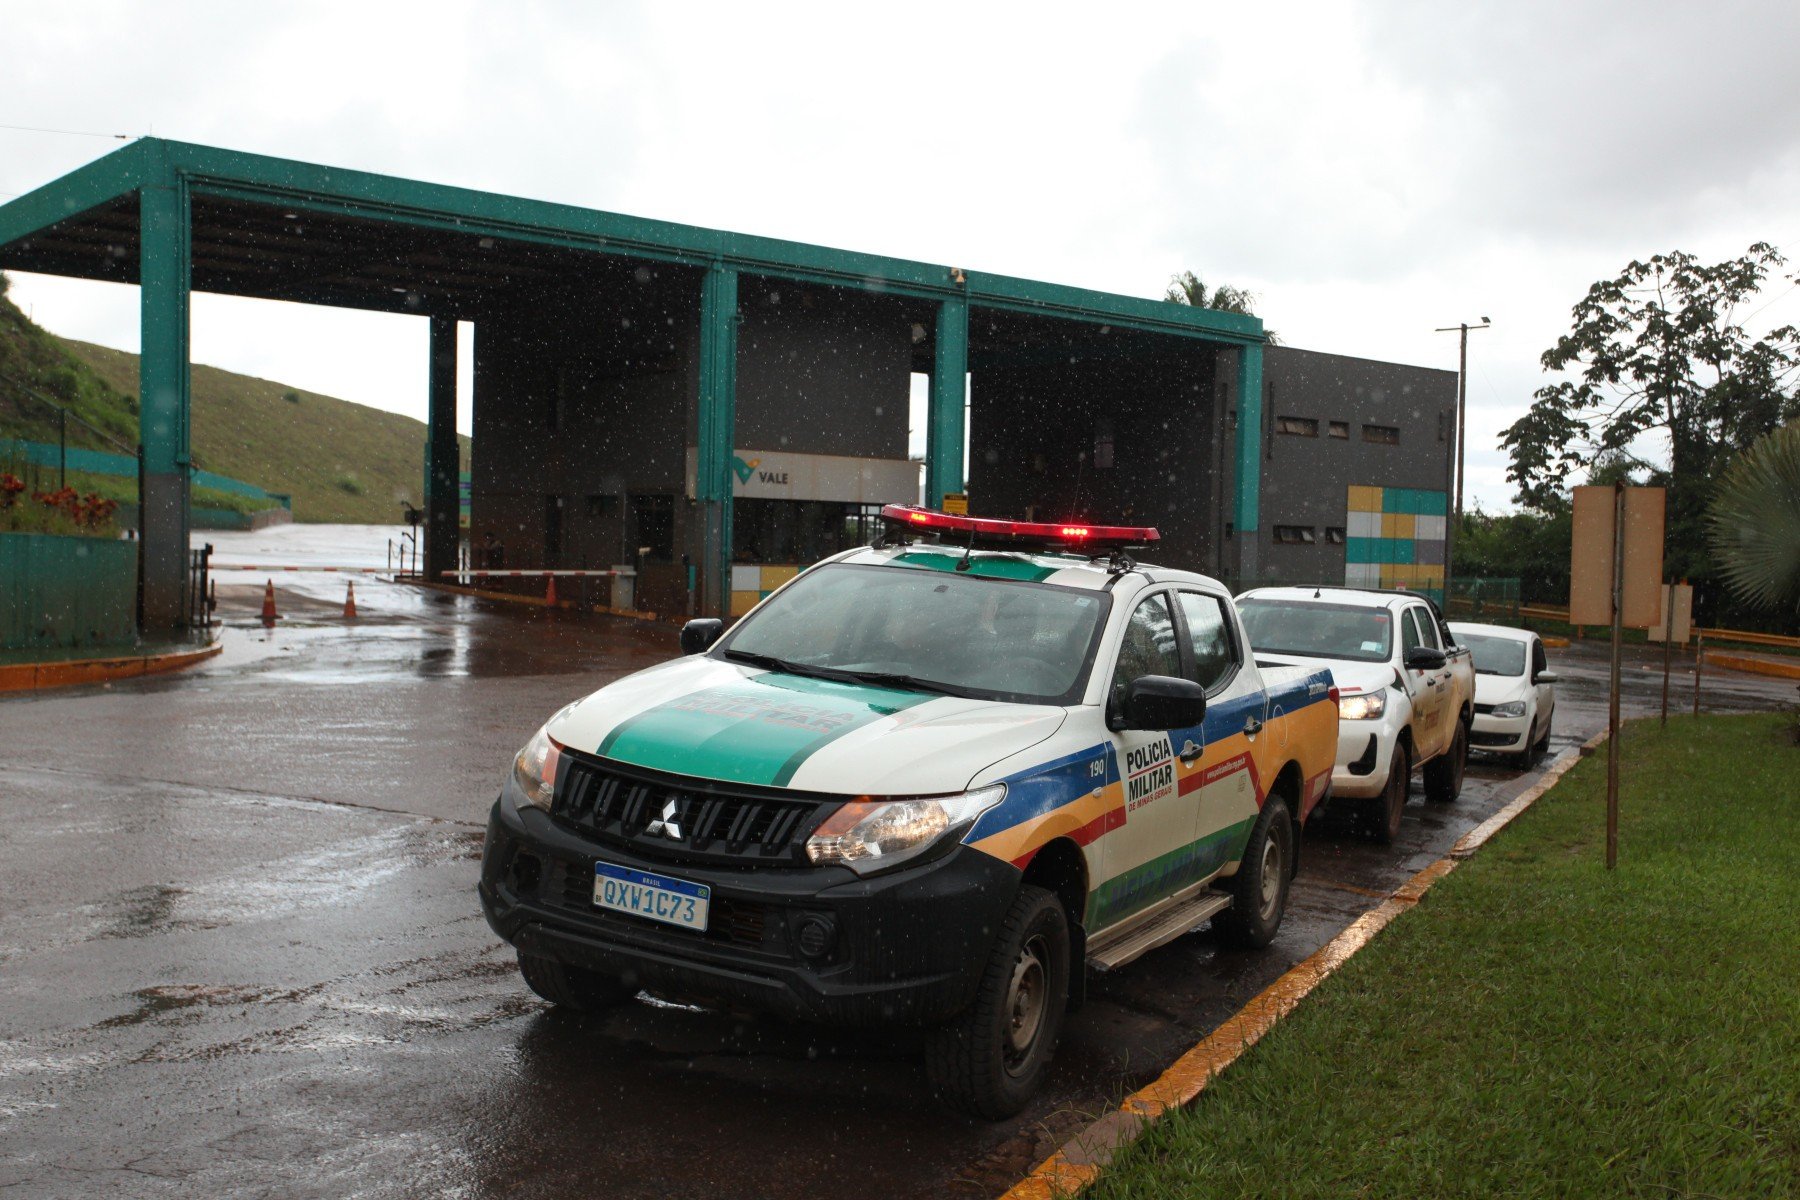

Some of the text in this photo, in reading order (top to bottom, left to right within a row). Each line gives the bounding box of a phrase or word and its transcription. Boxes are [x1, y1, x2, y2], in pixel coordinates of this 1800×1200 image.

[759, 471, 788, 484] VALE
[1090, 759, 1104, 777] 190
[1129, 764, 1172, 802] MILITAR
[1129, 785, 1172, 812] DE MINAS GERAIS
[642, 877, 661, 887] BRASIL
[604, 880, 695, 922] QXW1C73
